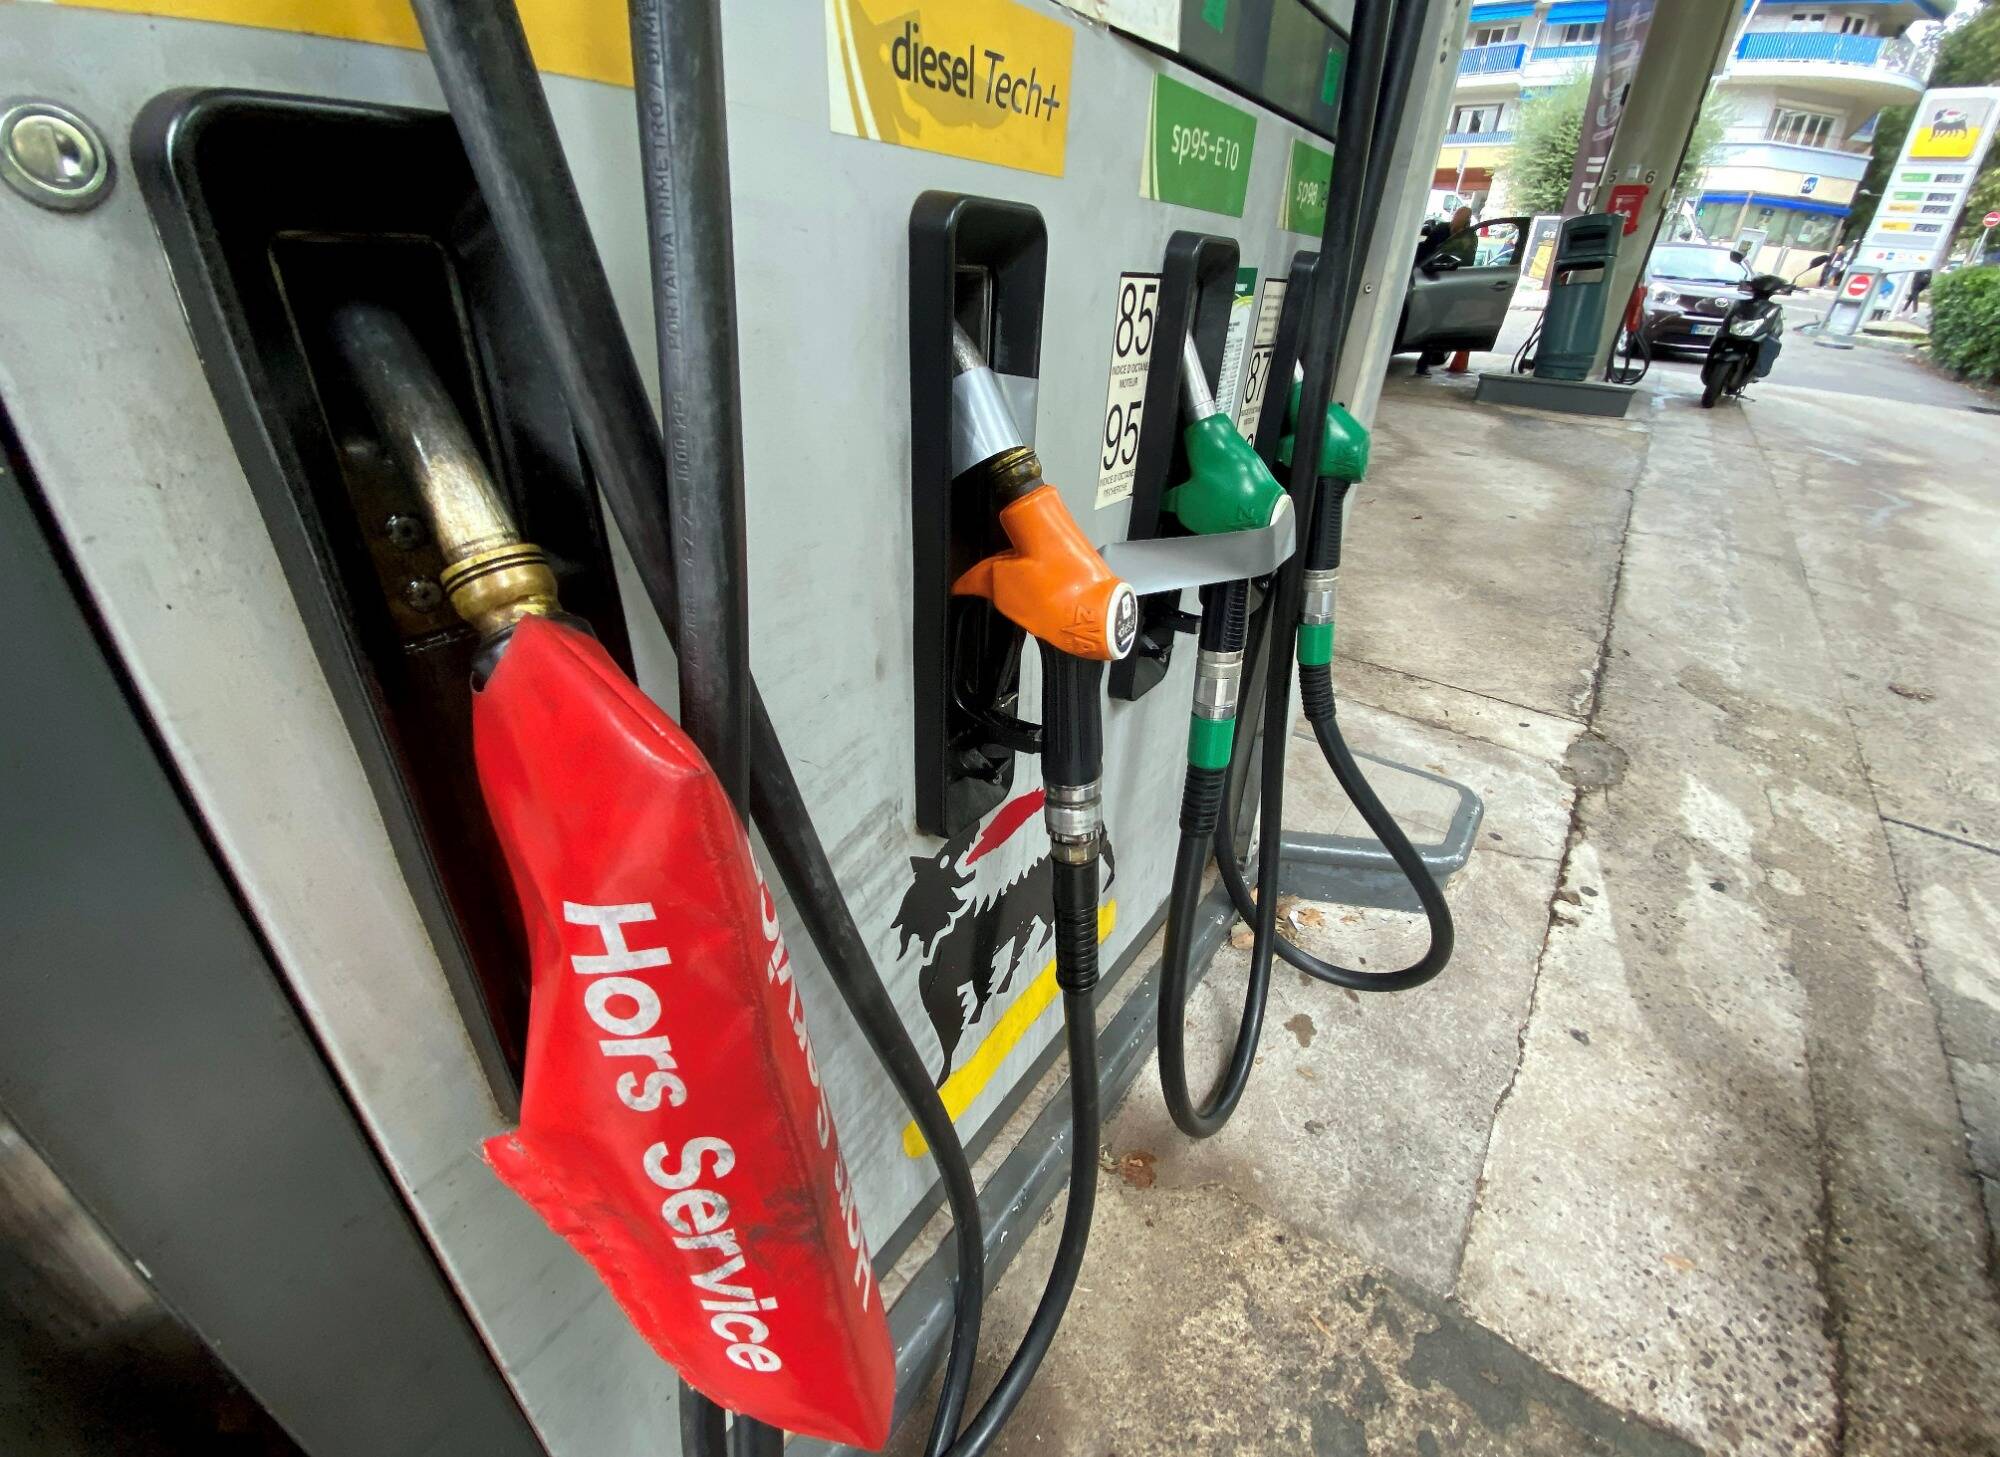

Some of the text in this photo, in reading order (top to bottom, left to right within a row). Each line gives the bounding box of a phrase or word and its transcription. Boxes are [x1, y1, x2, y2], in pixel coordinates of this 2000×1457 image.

[892, 21, 1060, 121] diesel Tech+
[650, 103, 674, 219] INMETRO
[1171, 124, 1240, 171] sp95-E10
[1645, 170, 1655, 184] 6
[1296, 181, 1319, 209] sp98
[659, 233, 682, 350] PORTARIA
[1116, 283, 1157, 358] 85
[1245, 351, 1272, 404] 87
[1103, 400, 1142, 470] 95
[562, 900, 689, 1112] Hors
[643, 1136, 783, 1373] Service
